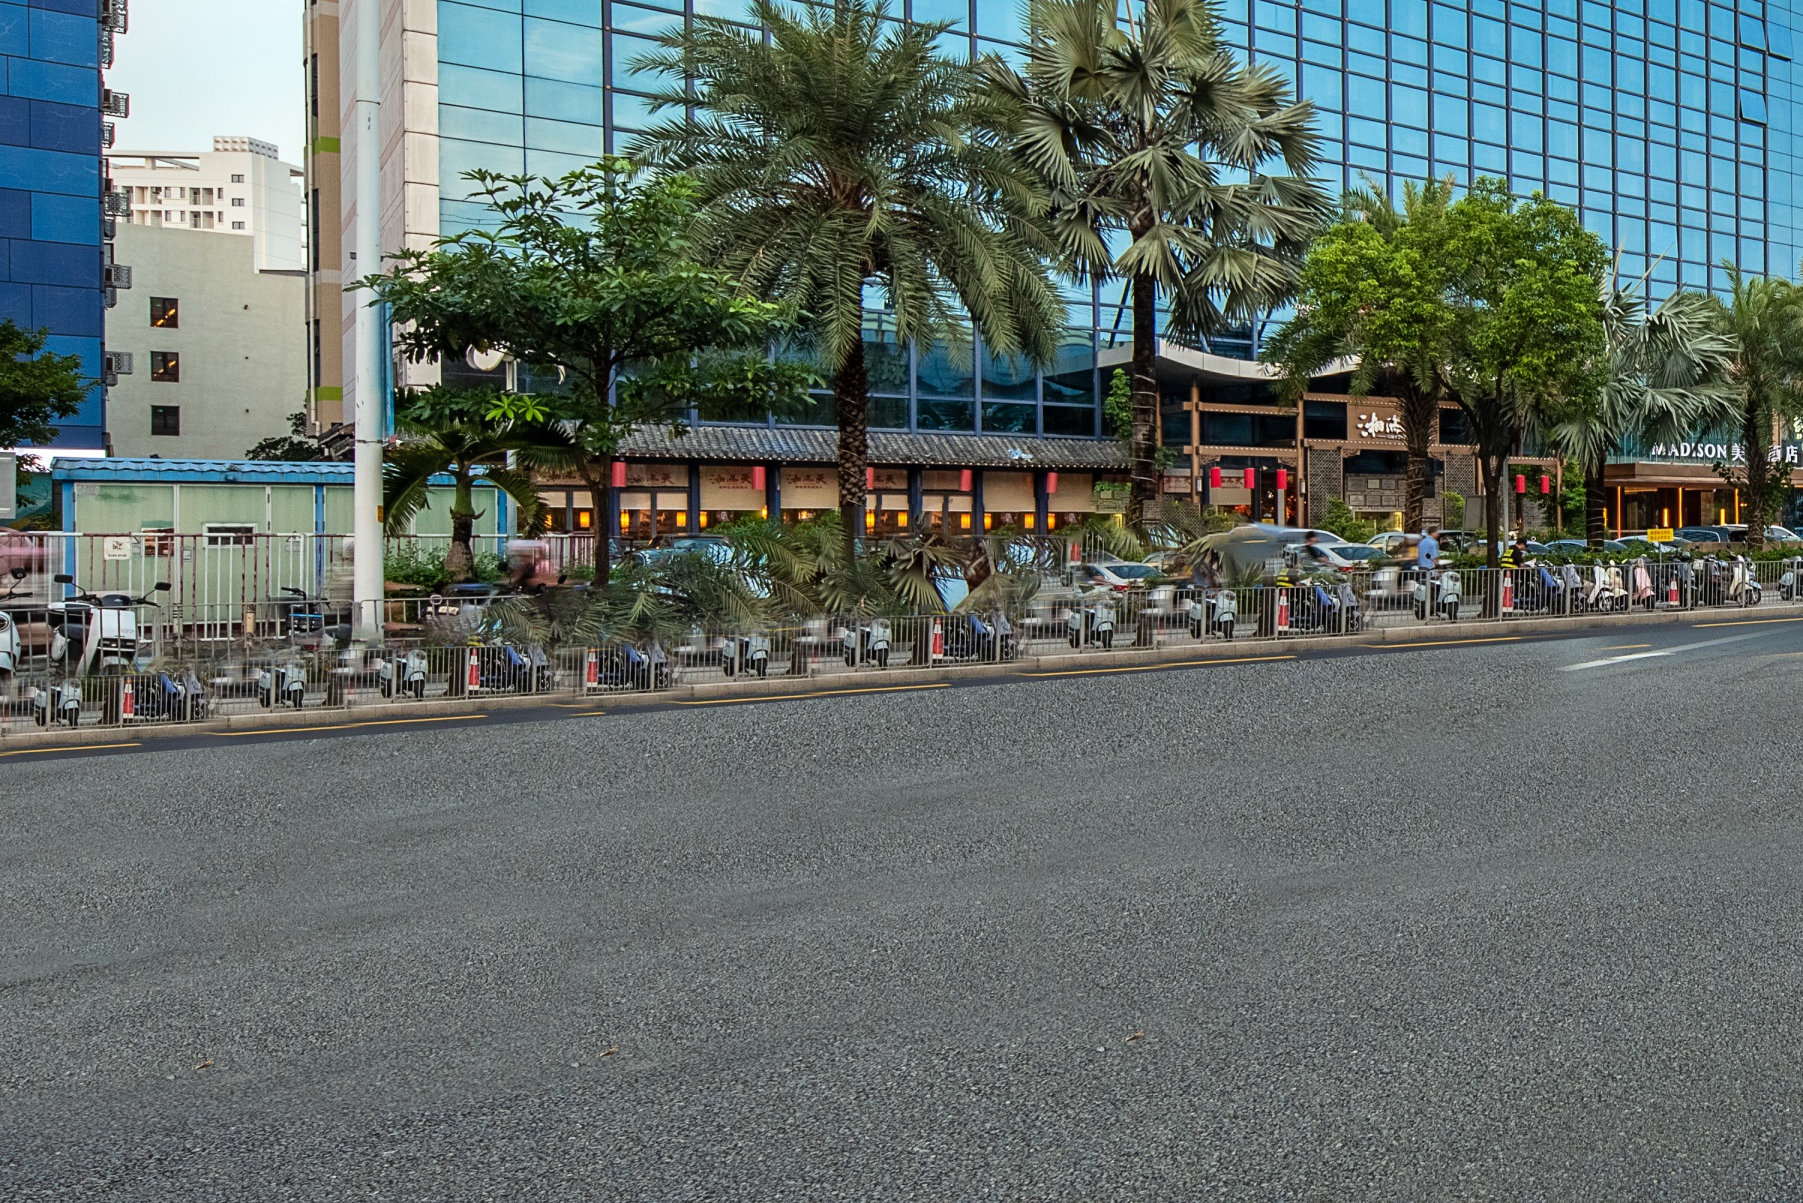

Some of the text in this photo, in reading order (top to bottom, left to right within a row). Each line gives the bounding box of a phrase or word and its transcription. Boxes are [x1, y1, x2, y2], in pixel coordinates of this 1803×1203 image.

[1651, 442, 1799, 464] MADISON 美酒店
